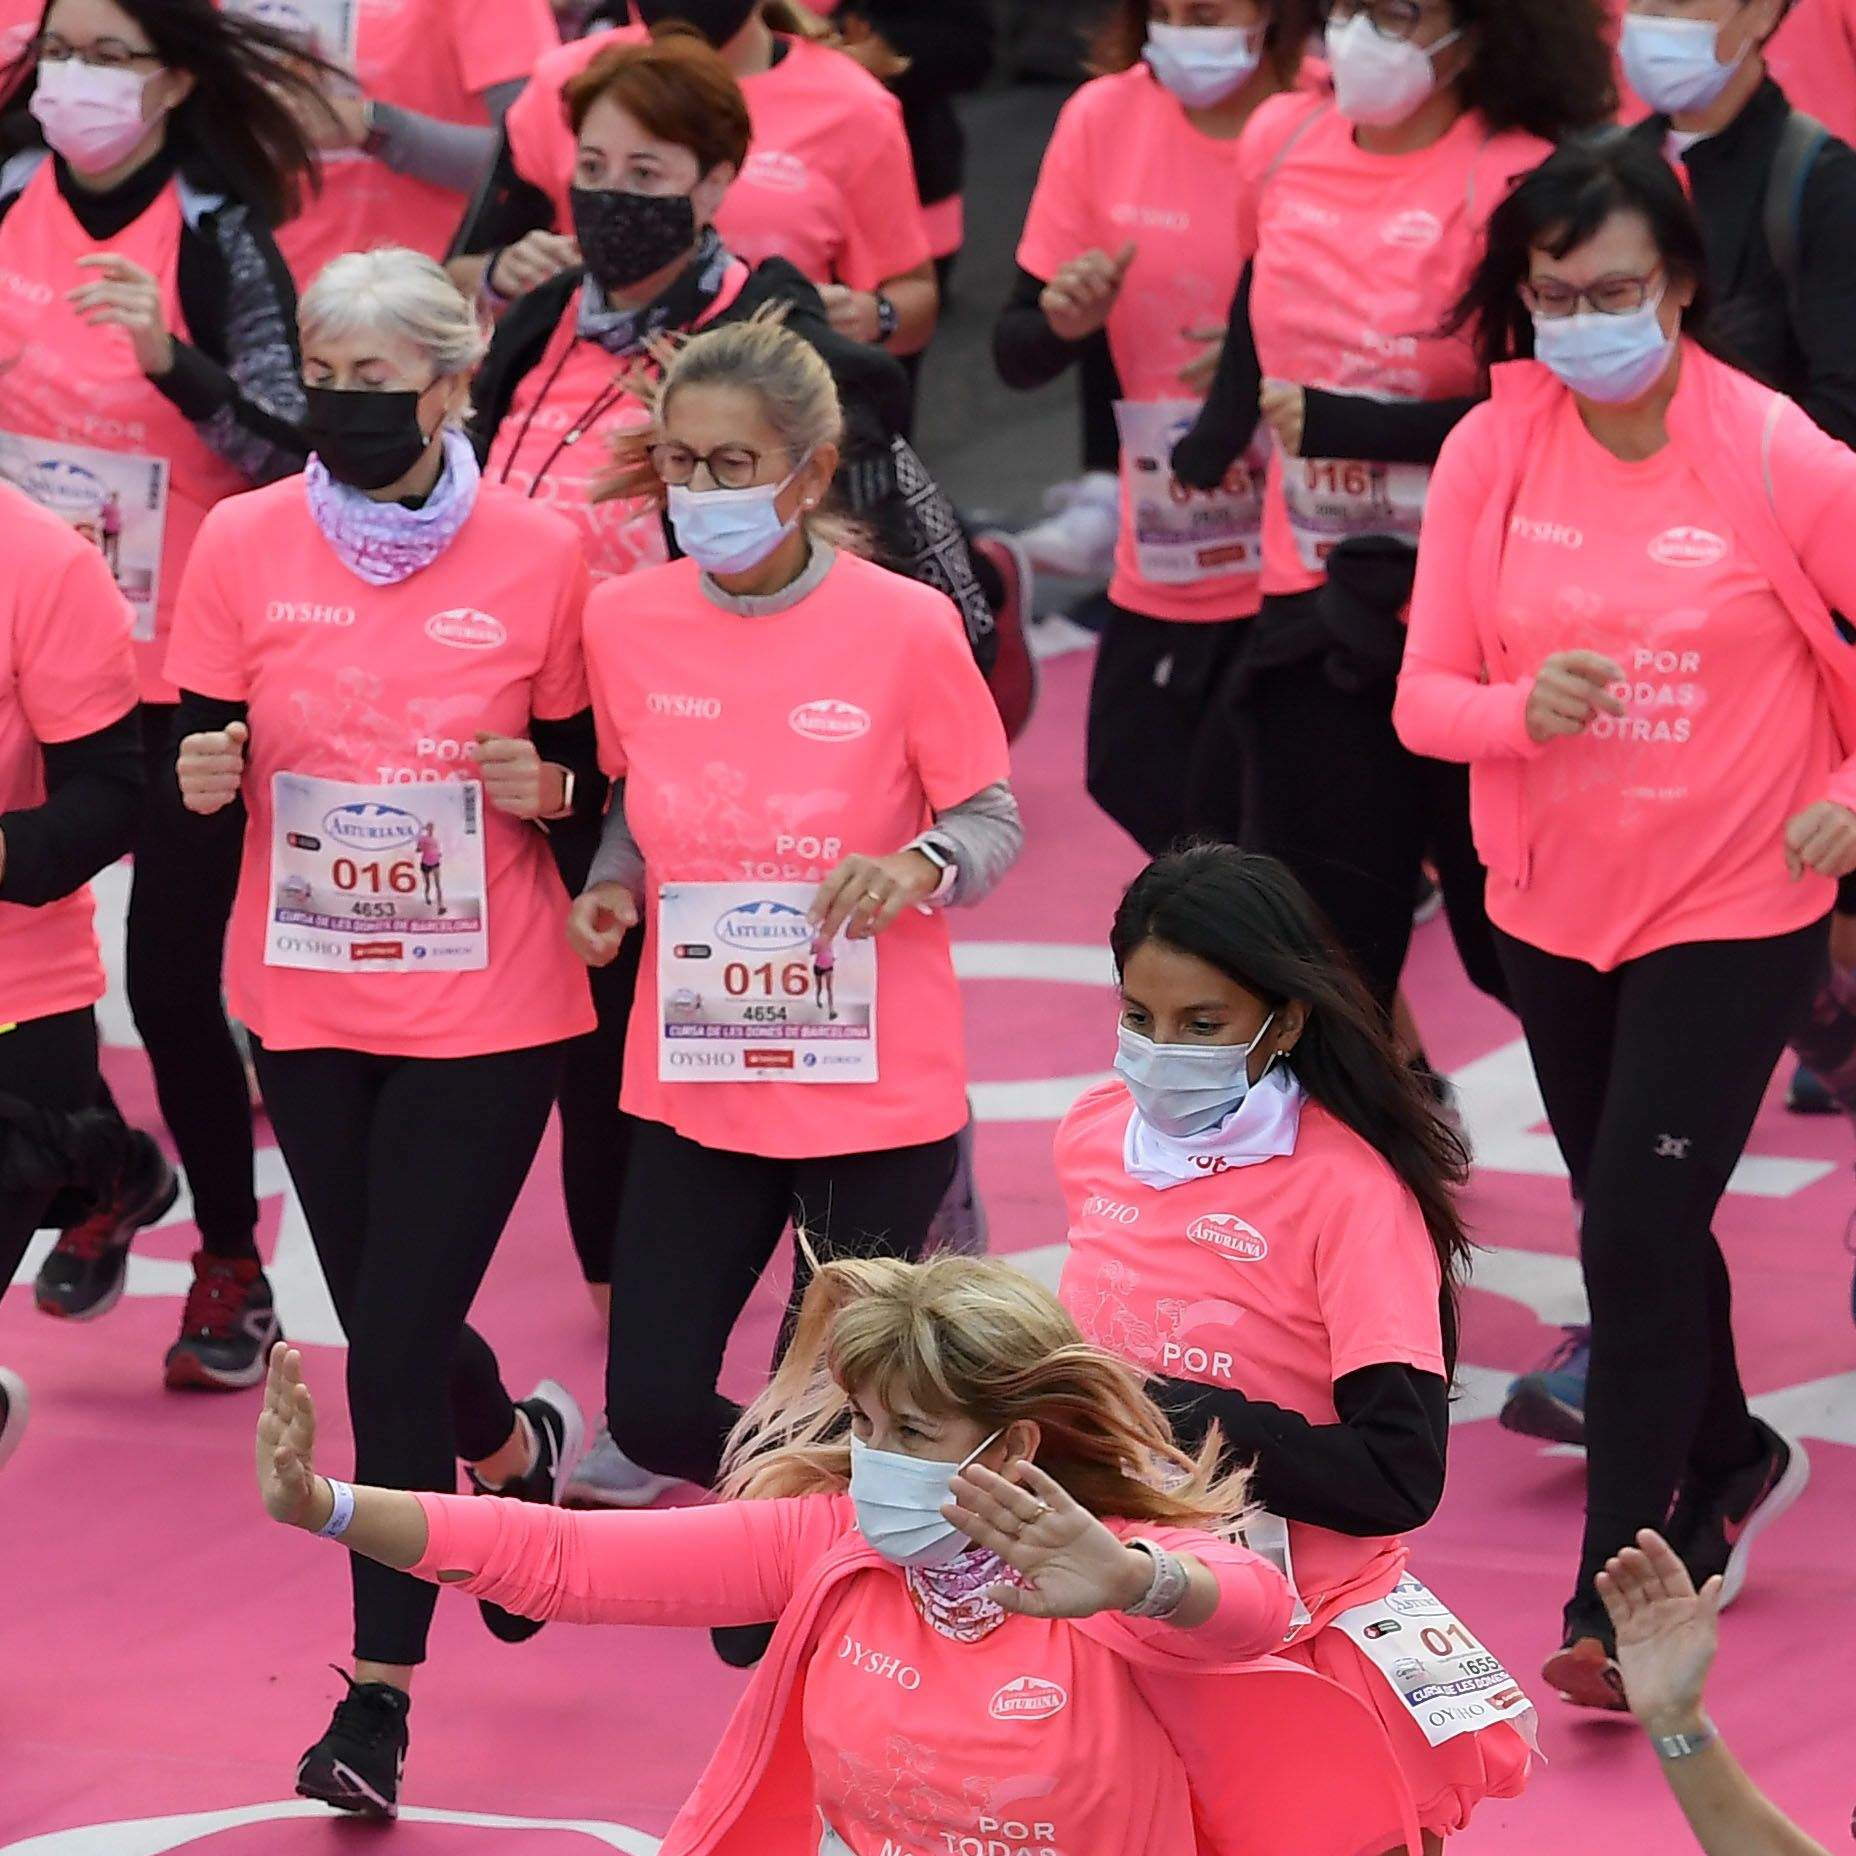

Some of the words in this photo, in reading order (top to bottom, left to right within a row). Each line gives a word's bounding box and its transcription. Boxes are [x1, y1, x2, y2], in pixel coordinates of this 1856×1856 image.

[266, 600, 355, 628] OYSHO
[1634, 648, 1700, 674] POR
[648, 692, 723, 720] OYSHO
[1608, 681, 1697, 708] ODAS
[1591, 716, 1692, 743] OTRAS
[775, 834, 842, 860] POR
[331, 858, 418, 894] 016
[352, 901, 396, 918] 4653
[721, 918, 808, 939] ASTURIANA
[276, 936, 343, 957] OYSHO
[722, 961, 810, 997] 016
[742, 1005, 788, 1022] 4654
[670, 1051, 736, 1067] OYSHO
[1191, 1221, 1263, 1258] ASTURIANA
[1162, 1342, 1234, 1379] POR
[1420, 1622, 1476, 1657] 01
[1456, 1680, 1475, 1694] LES
[979, 1816, 1056, 1843] POR
